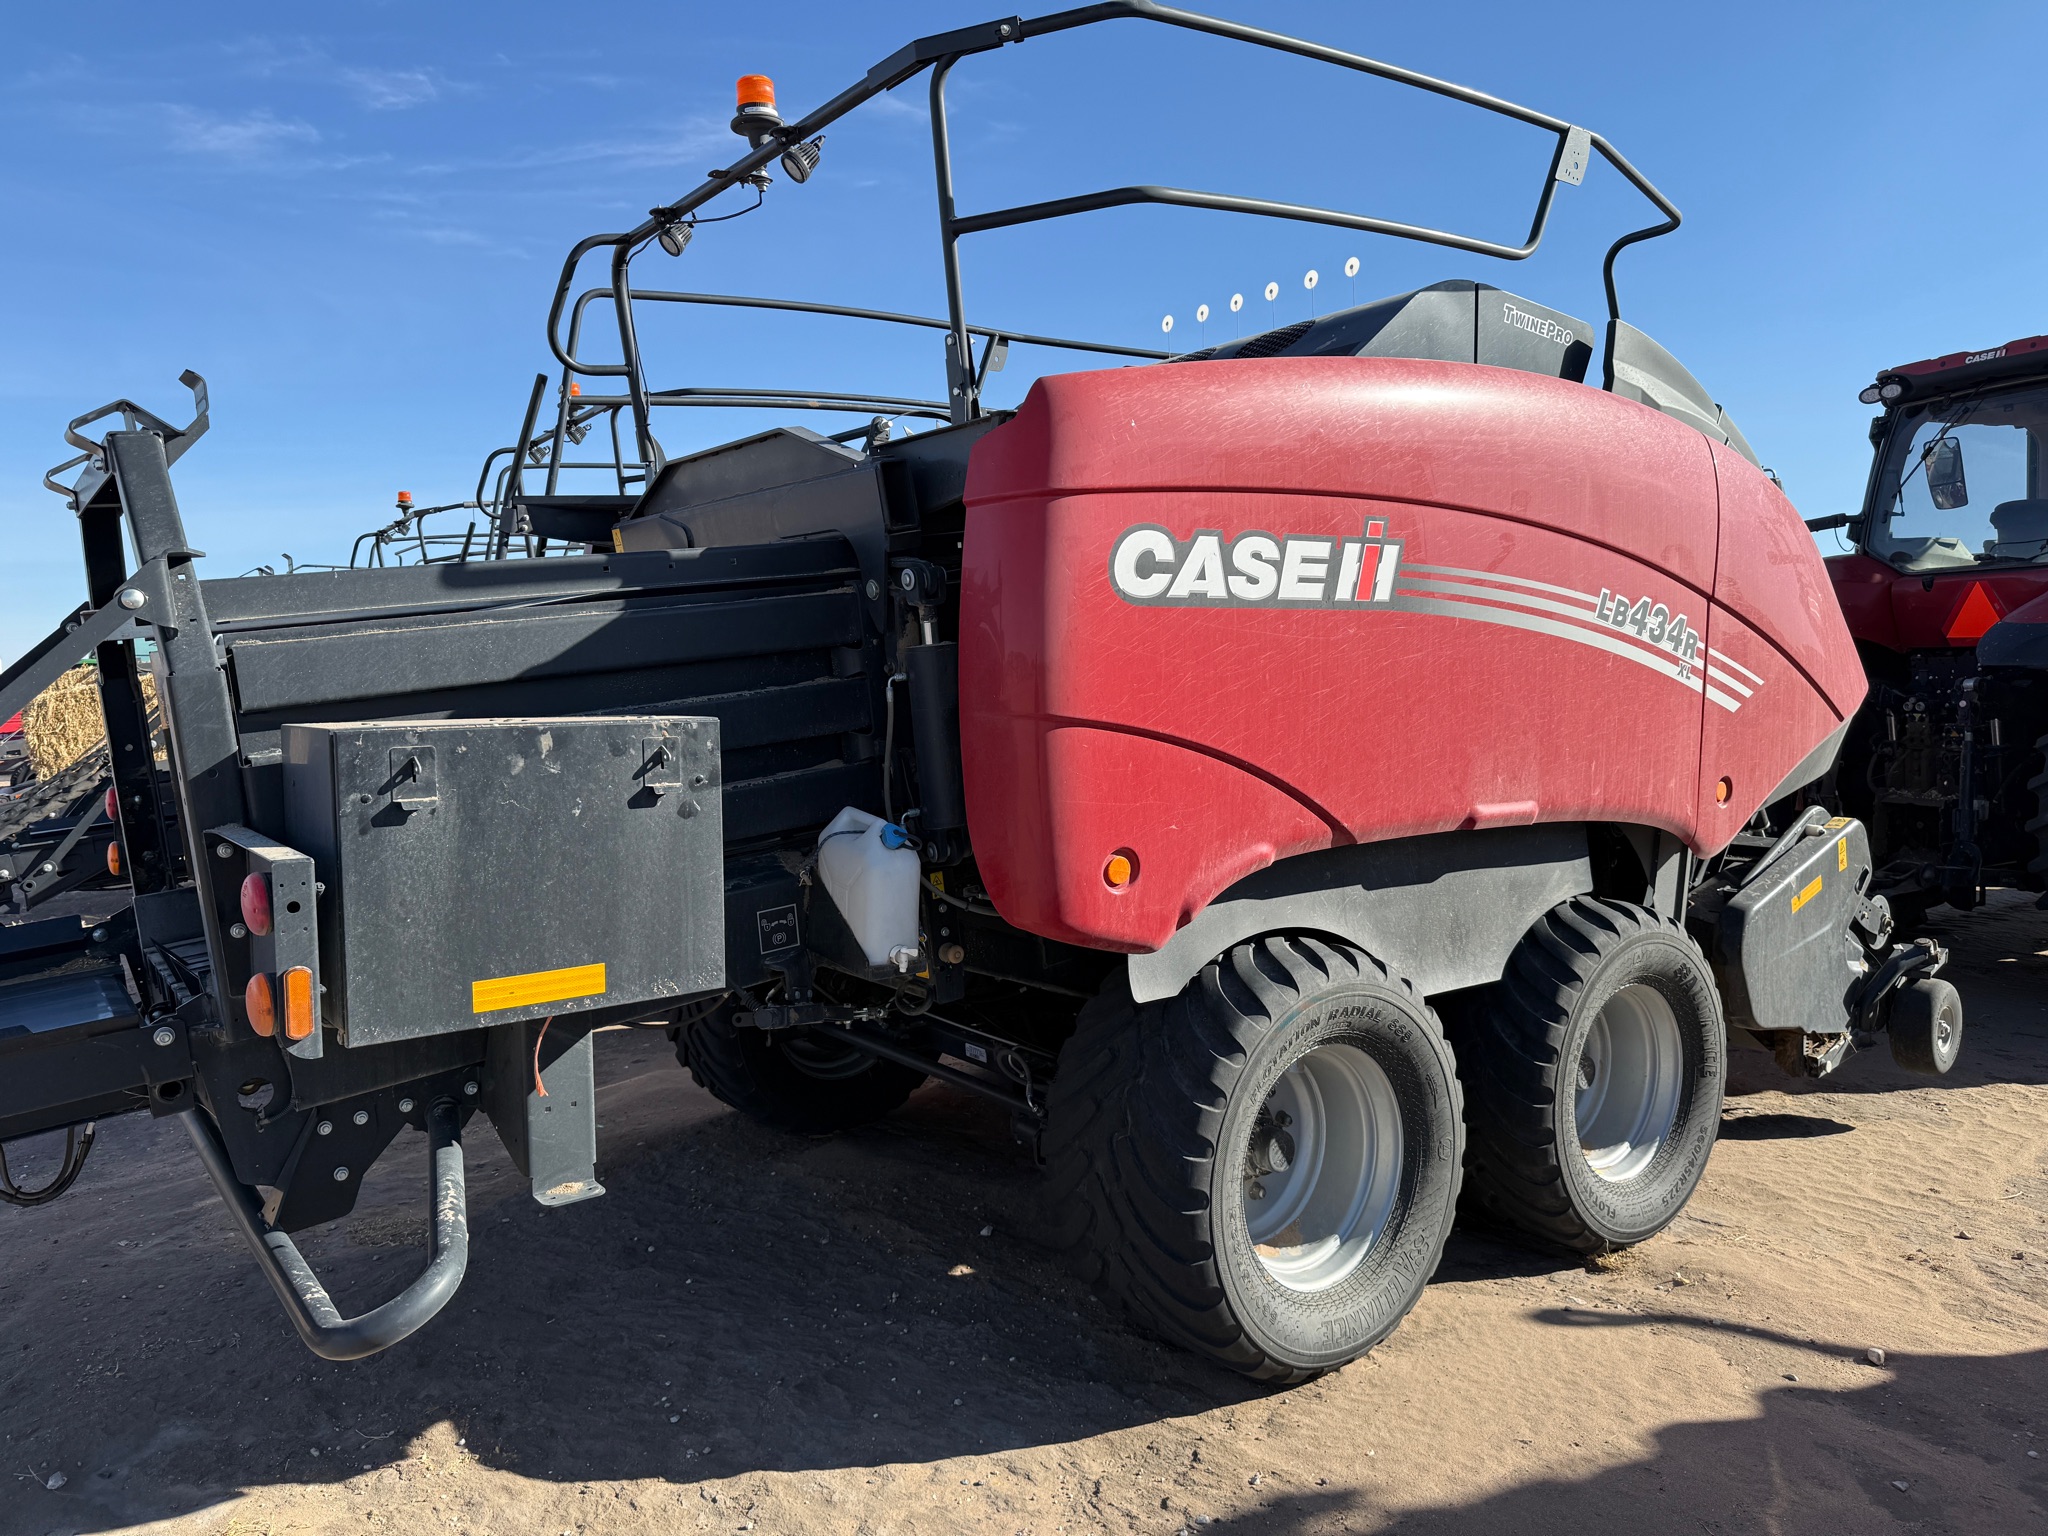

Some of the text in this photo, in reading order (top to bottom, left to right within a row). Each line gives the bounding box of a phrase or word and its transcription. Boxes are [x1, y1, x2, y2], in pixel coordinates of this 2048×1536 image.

[1594, 588, 1699, 661] LB434R
[1327, 1004, 1382, 1023] RADIAL
[1661, 1125, 1708, 1207] 560/45R22.5
